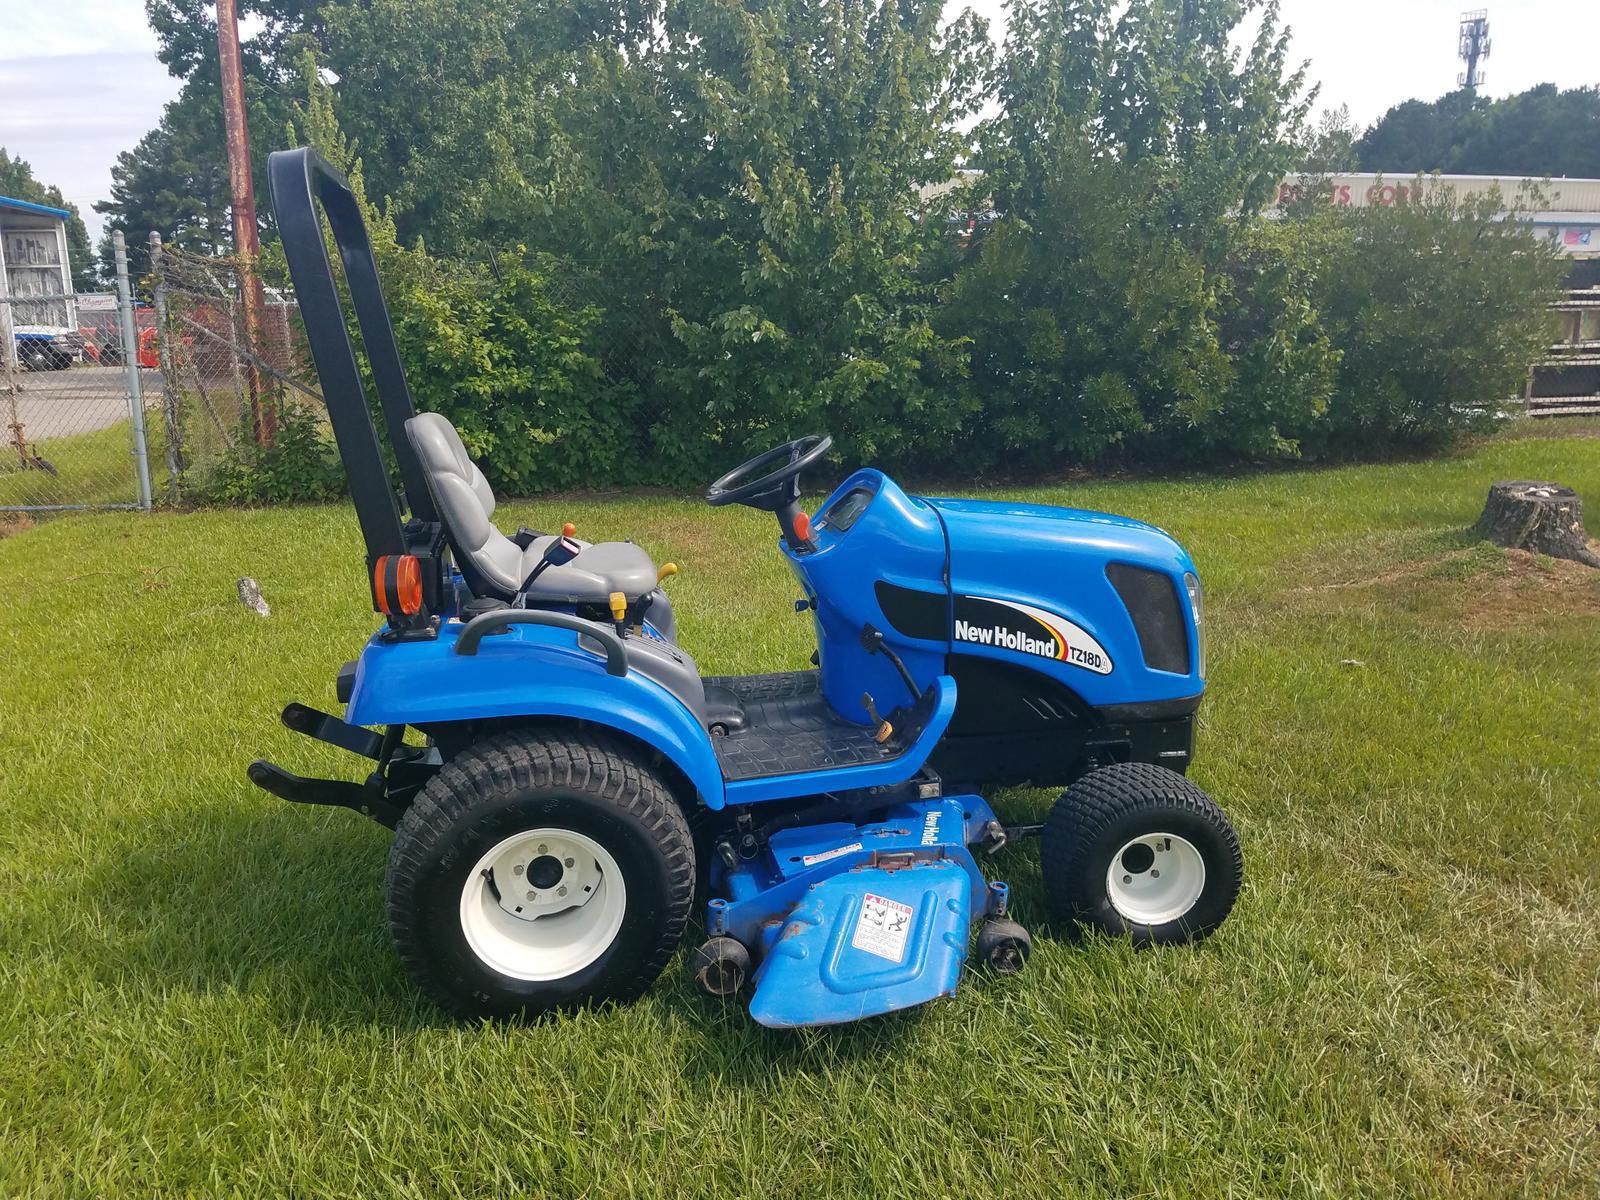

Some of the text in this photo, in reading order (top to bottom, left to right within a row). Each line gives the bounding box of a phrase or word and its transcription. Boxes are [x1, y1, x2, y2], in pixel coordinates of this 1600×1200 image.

[955, 619, 1055, 658] New Holland
[925, 811, 942, 827] New
